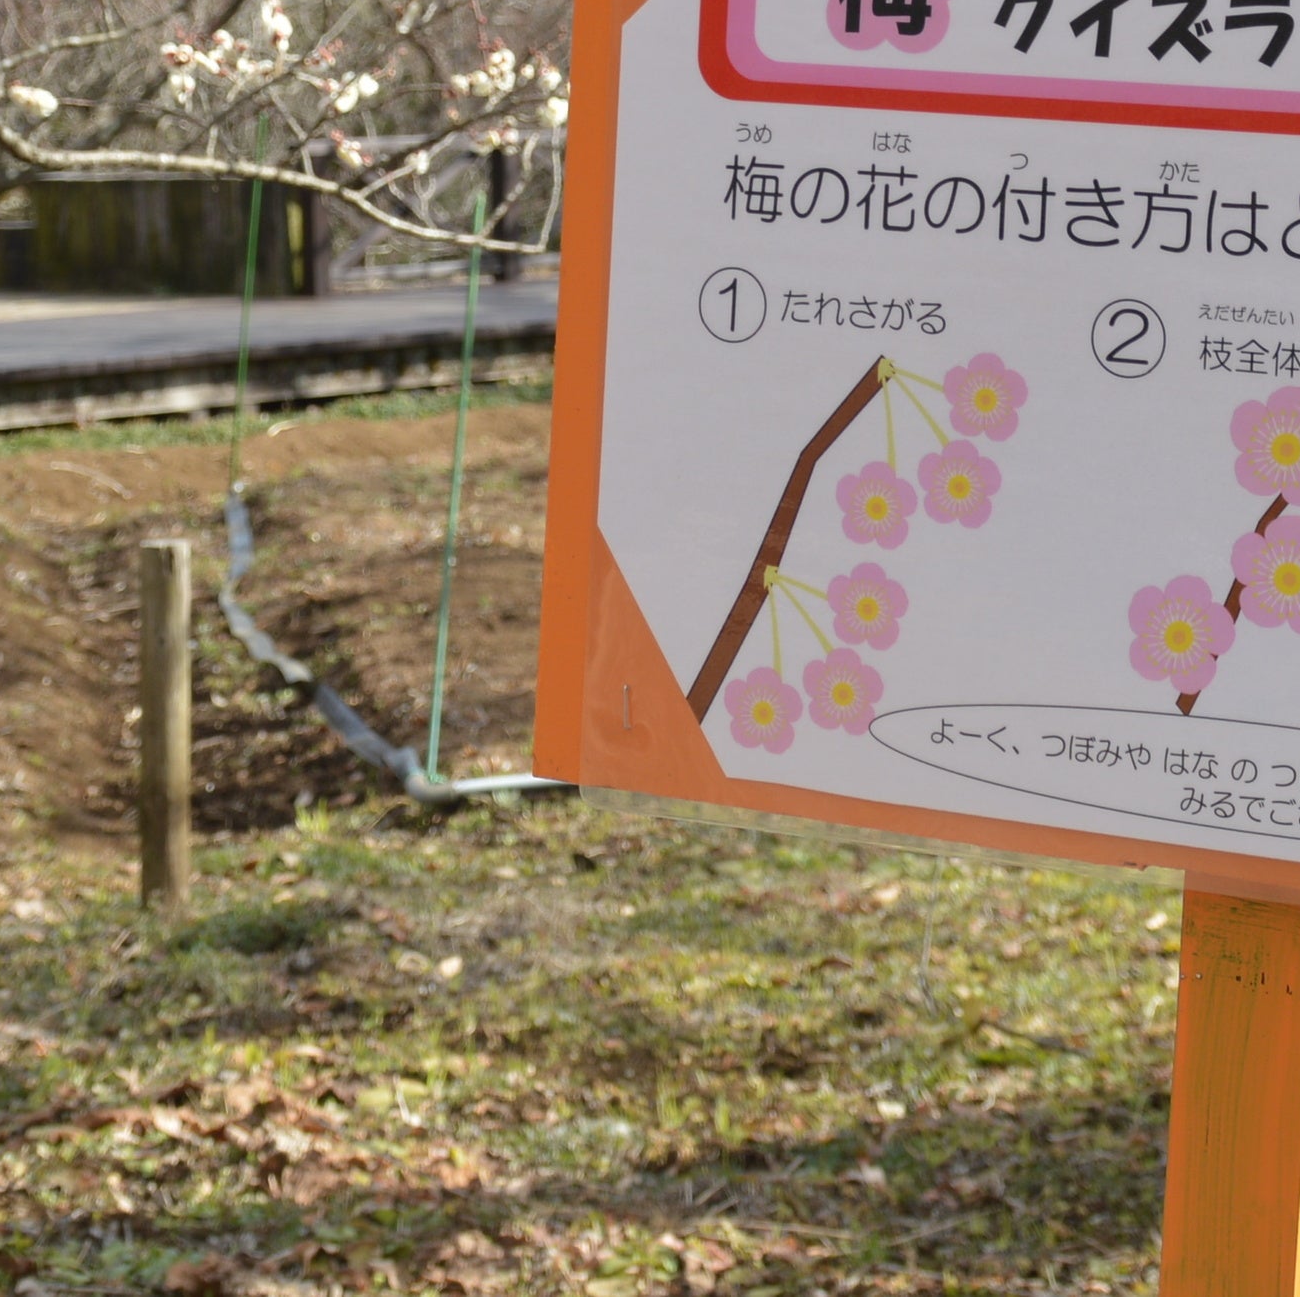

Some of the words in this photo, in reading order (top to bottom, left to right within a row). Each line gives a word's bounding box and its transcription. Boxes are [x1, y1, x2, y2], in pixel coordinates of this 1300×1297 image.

[736, 123, 772, 144] うめ
[873, 132, 911, 153] はな
[1159, 161, 1200, 183] かた
[781, 290, 946, 335] たれさがる
[1199, 304, 1294, 325] えだぜんたい
